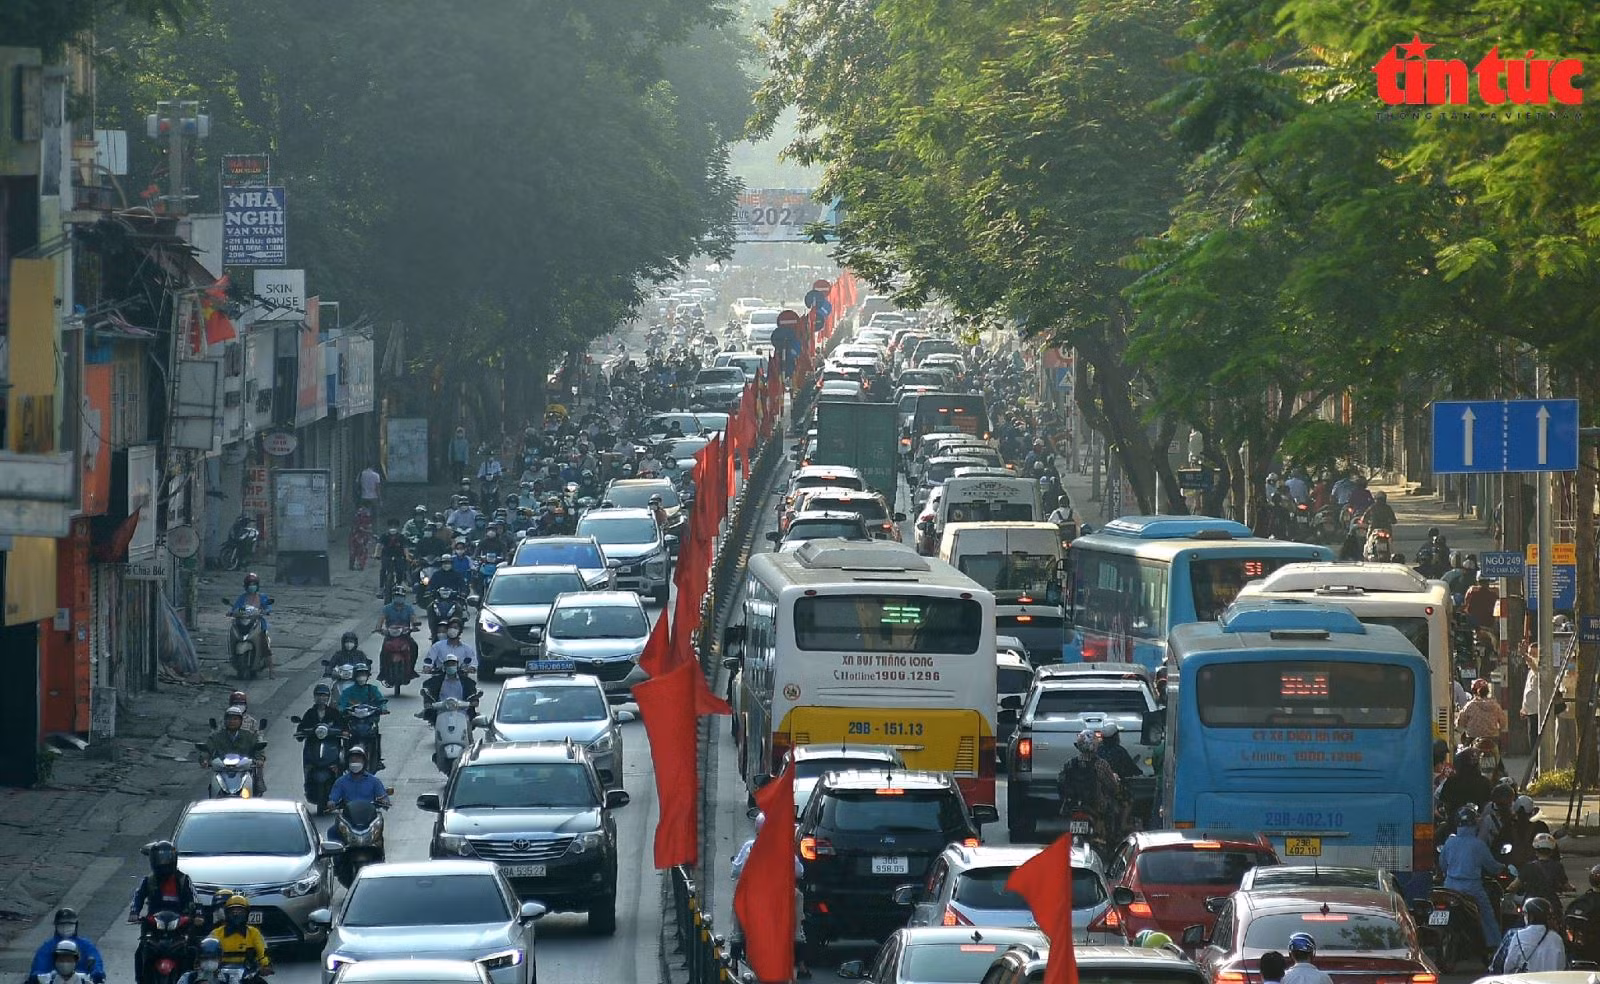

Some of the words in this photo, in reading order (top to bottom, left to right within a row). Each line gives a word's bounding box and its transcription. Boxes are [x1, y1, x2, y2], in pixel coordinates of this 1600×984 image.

[228, 188, 279, 208] NHÀ
[225, 206, 284, 226] NGHỈ
[266, 283, 293, 294] SKIN
[856, 656, 873, 667] BUS
[909, 656, 934, 668] LONG
[848, 721, 871, 735] 29B
[883, 722, 924, 736] 151.13
